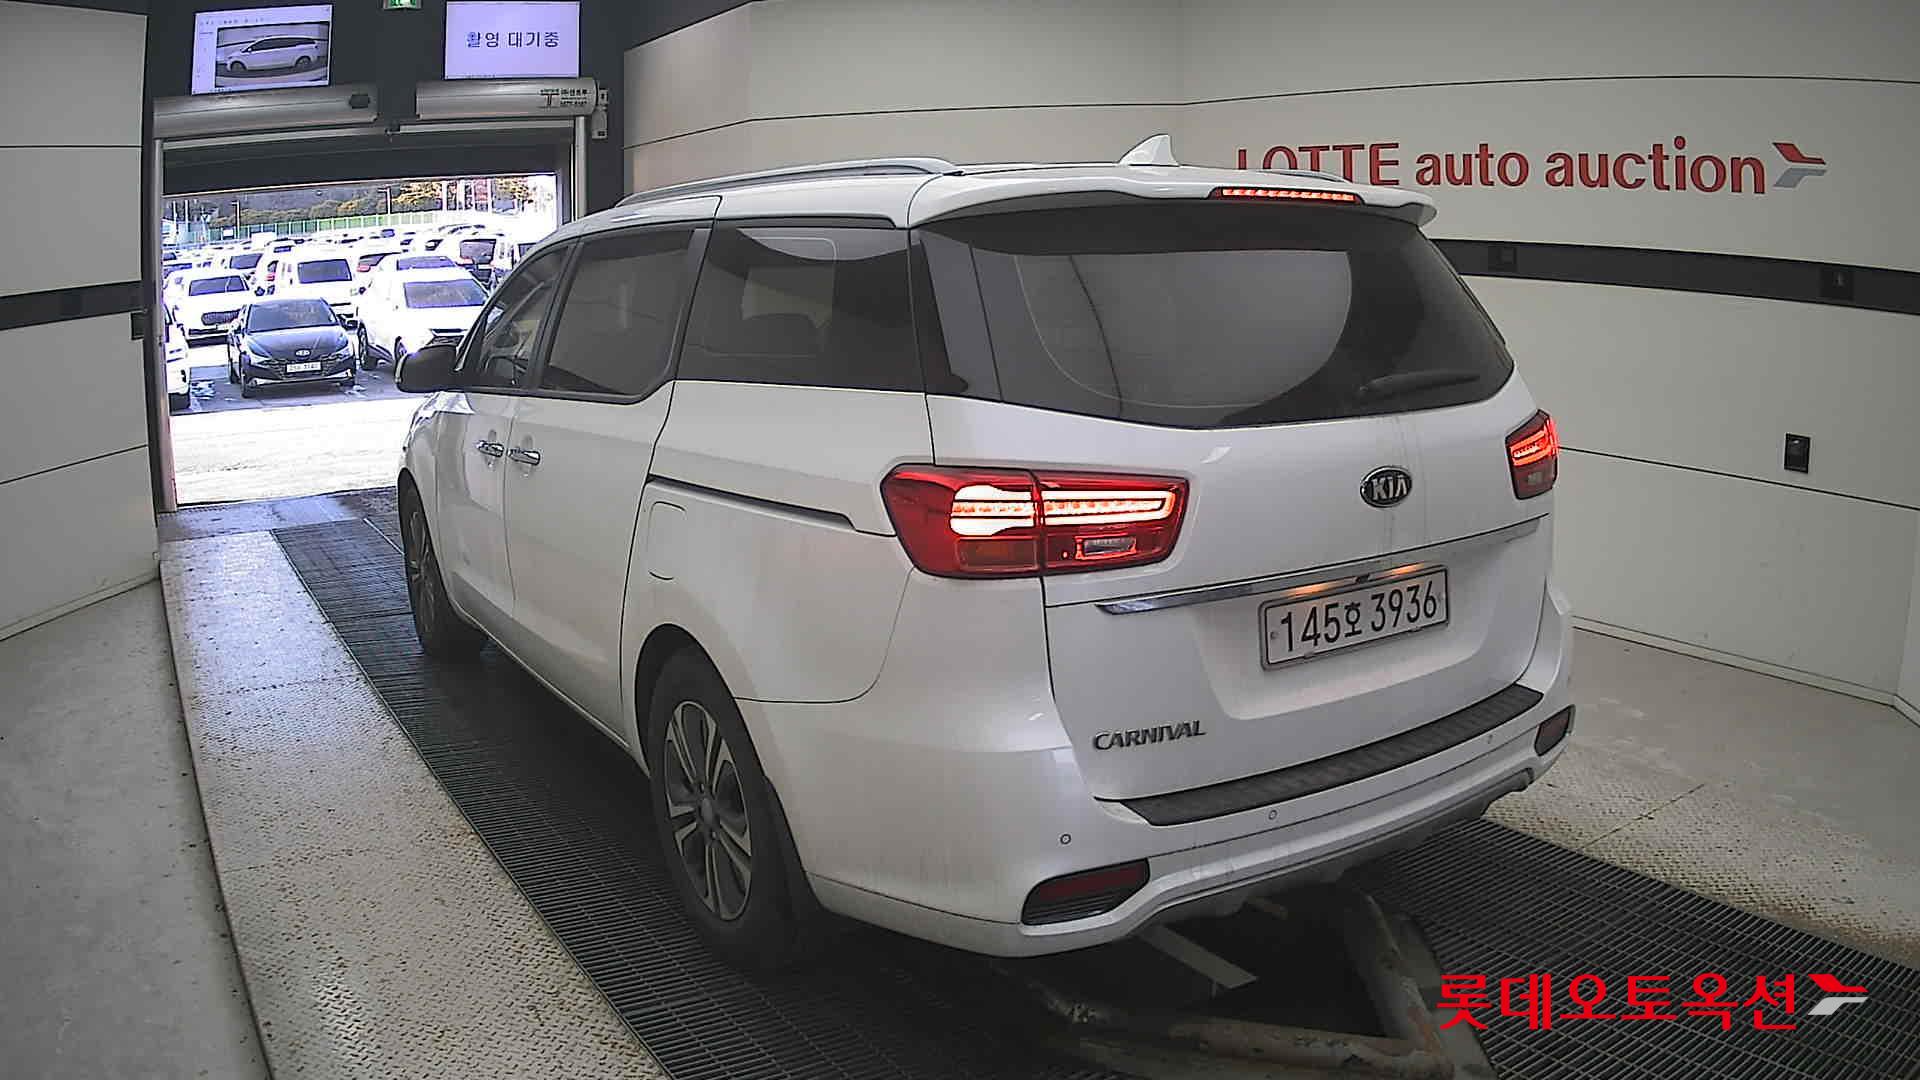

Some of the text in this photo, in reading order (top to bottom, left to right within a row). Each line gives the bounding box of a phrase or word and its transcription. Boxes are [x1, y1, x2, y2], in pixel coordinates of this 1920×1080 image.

[508, 31, 560, 48] 대기중
[1415, 143, 1529, 187] auto
[1545, 136, 1766, 194] auction
[1371, 475, 1408, 501] KIA
[1281, 581, 1437, 651] 145호 3936
[1093, 720, 1206, 750] CARNIVAL
